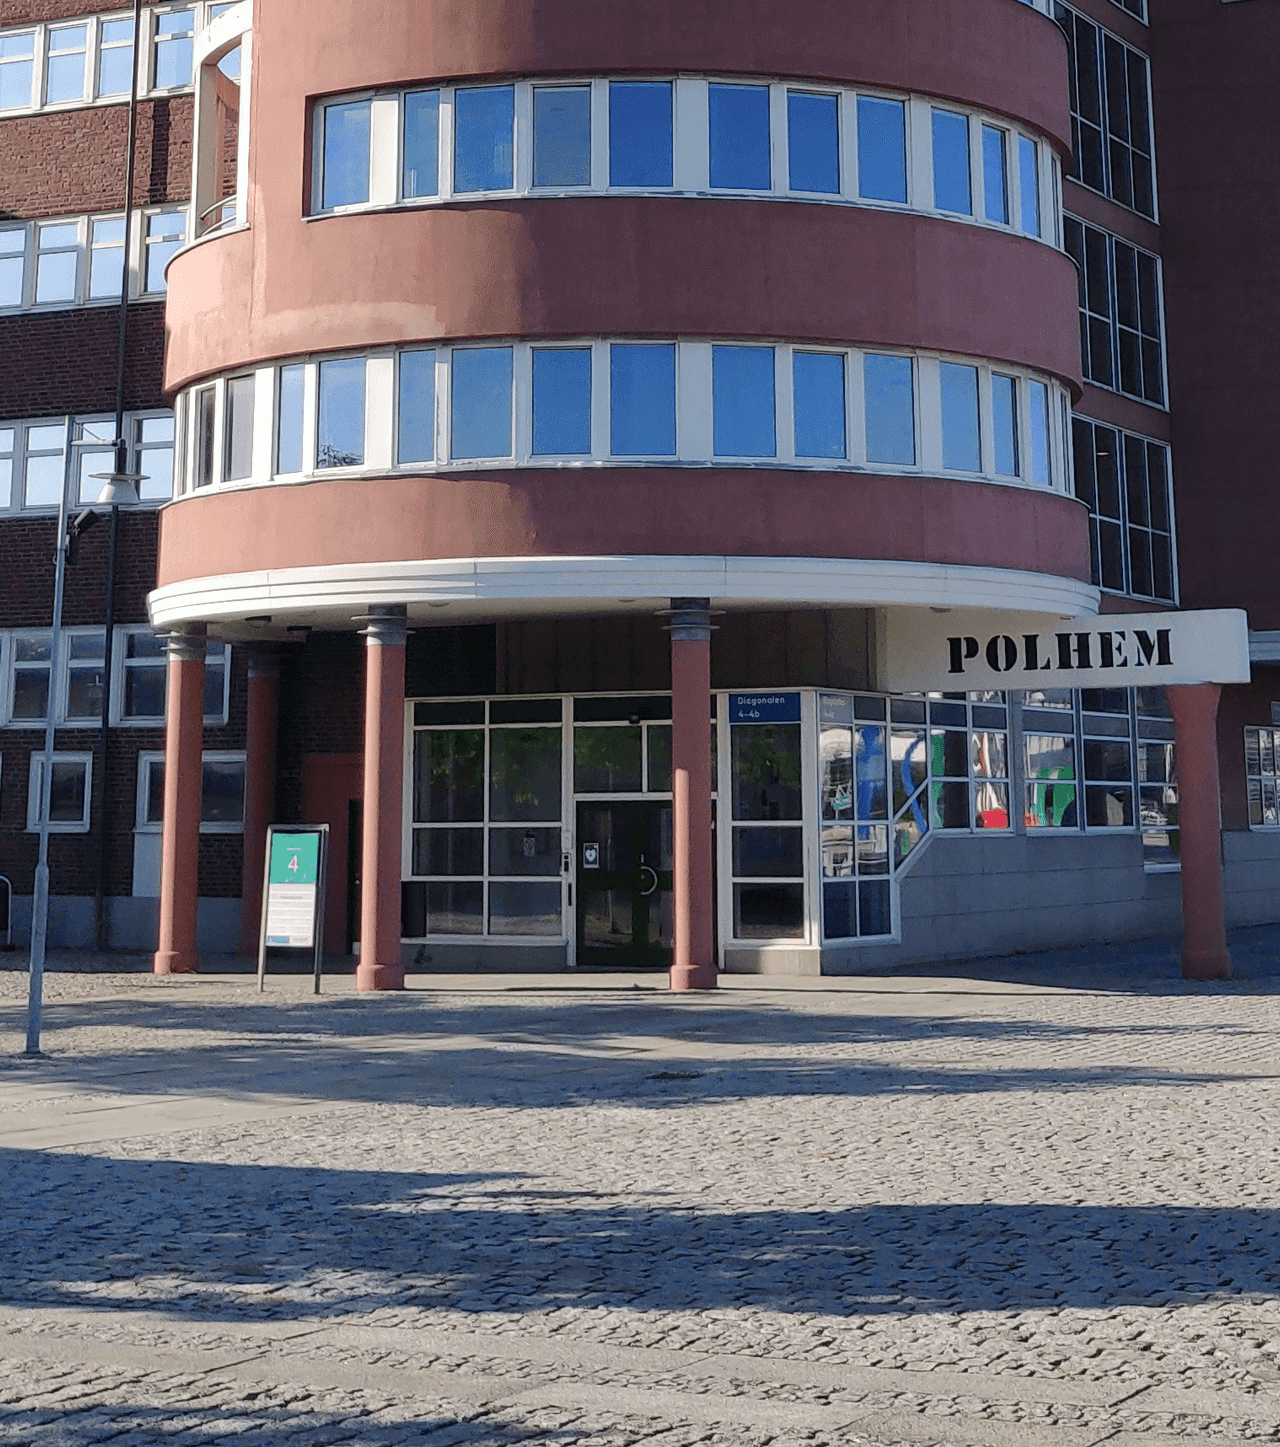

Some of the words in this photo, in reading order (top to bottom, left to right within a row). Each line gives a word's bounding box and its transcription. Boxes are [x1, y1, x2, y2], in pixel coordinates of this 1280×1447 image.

[946, 629, 1173, 673] POLHEM
[738, 696, 785, 706] Diagonalen
[287, 855, 299, 873] 4
